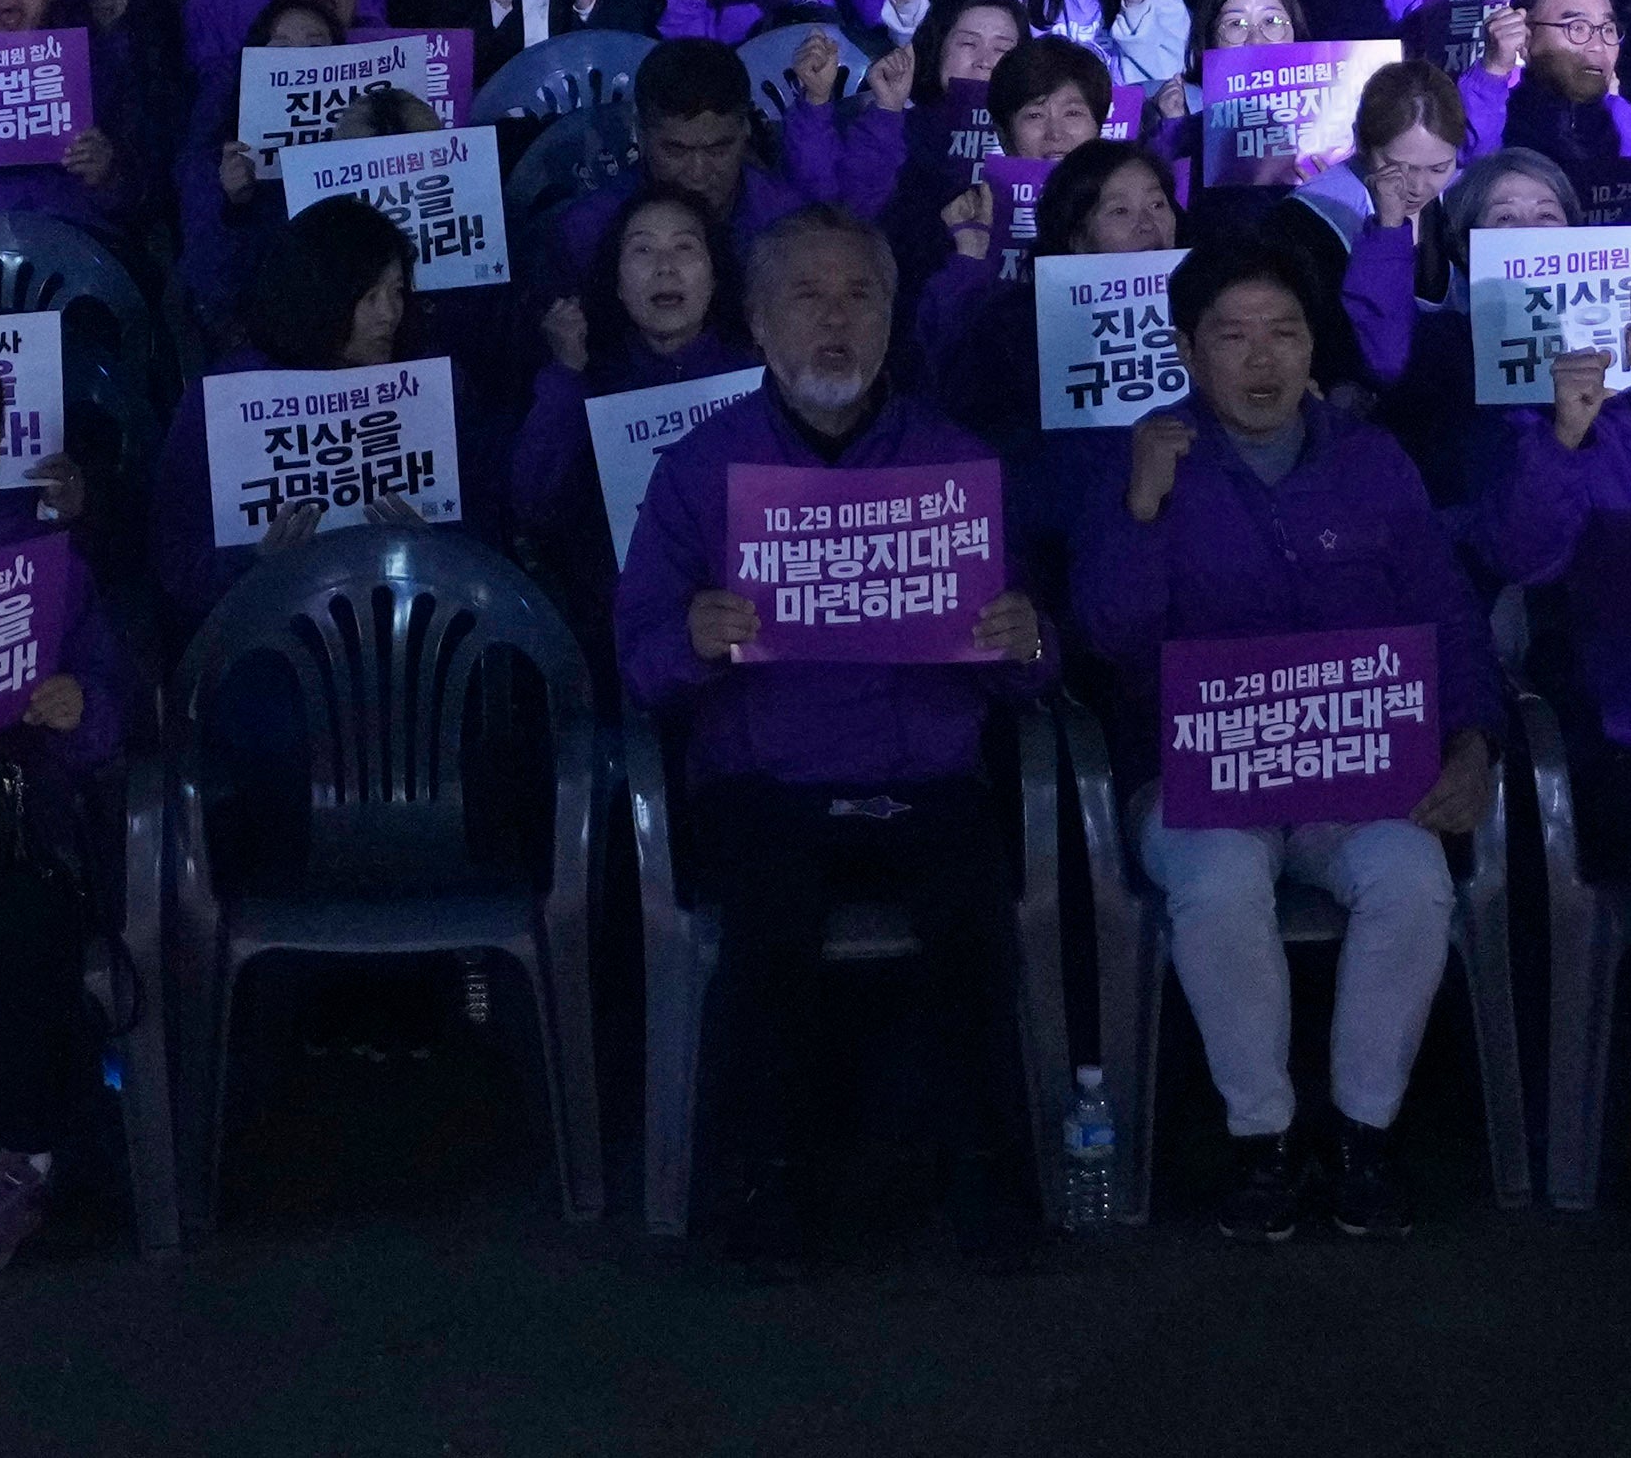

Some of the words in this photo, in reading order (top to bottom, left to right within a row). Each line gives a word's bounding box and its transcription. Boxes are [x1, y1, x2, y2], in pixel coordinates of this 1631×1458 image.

[268, 70, 317, 91] 10.29
[322, 60, 368, 84] 이태원
[1226, 72, 1273, 93] 10.29
[312, 167, 361, 190] 10.29
[365, 153, 425, 184] 이태원
[1503, 256, 1563, 281] 10.29
[1568, 246, 1631, 273] 이태원
[1068, 279, 1126, 306] 10.29
[239, 394, 300, 423] 10.29
[303, 385, 369, 415] 이태원
[263, 413, 402, 471] 진상을
[763, 506, 831, 532] 10.29
[836, 499, 913, 527] 이태원
[738, 515, 991, 582] 재발방지대책
[775, 573, 959, 625] 마련하라!
[1198, 673, 1264, 704] 10.29
[1271, 662, 1344, 696] 이태원
[1172, 682, 1425, 754] 재발방지대책
[1210, 738, 1392, 796] 마련하라!
